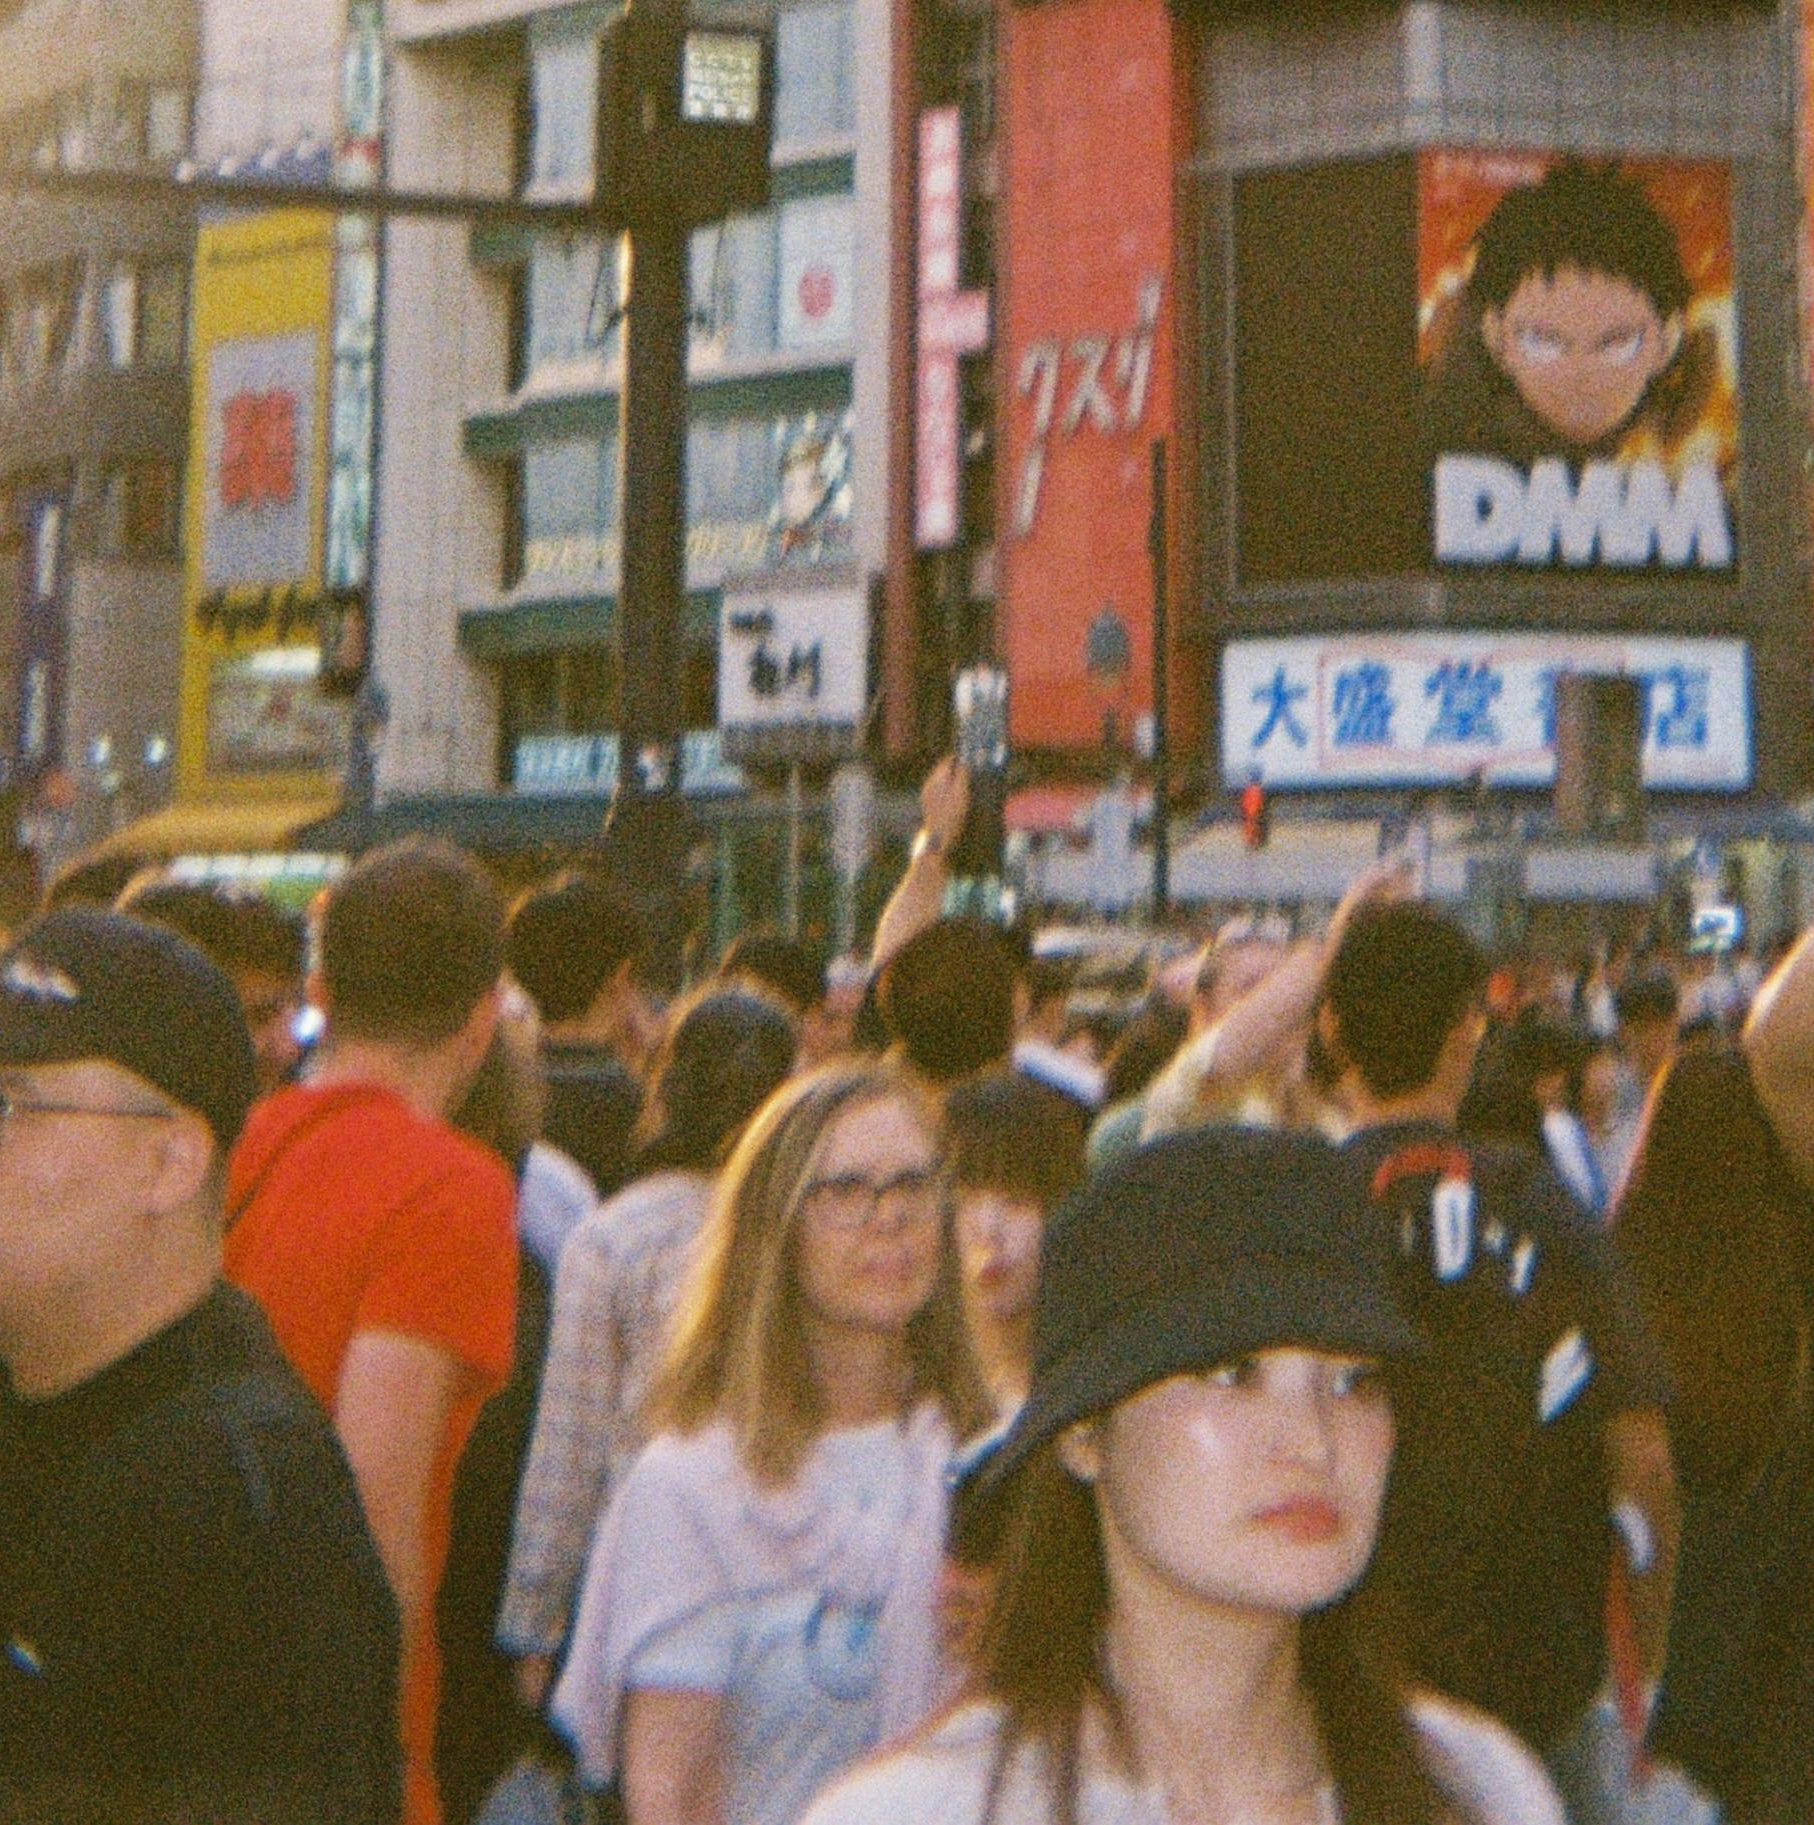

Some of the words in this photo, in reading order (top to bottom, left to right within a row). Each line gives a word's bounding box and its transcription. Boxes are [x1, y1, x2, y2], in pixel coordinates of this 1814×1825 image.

[1432, 452, 1736, 569] DMM
[1249, 656, 1709, 750] 大盛堂店
